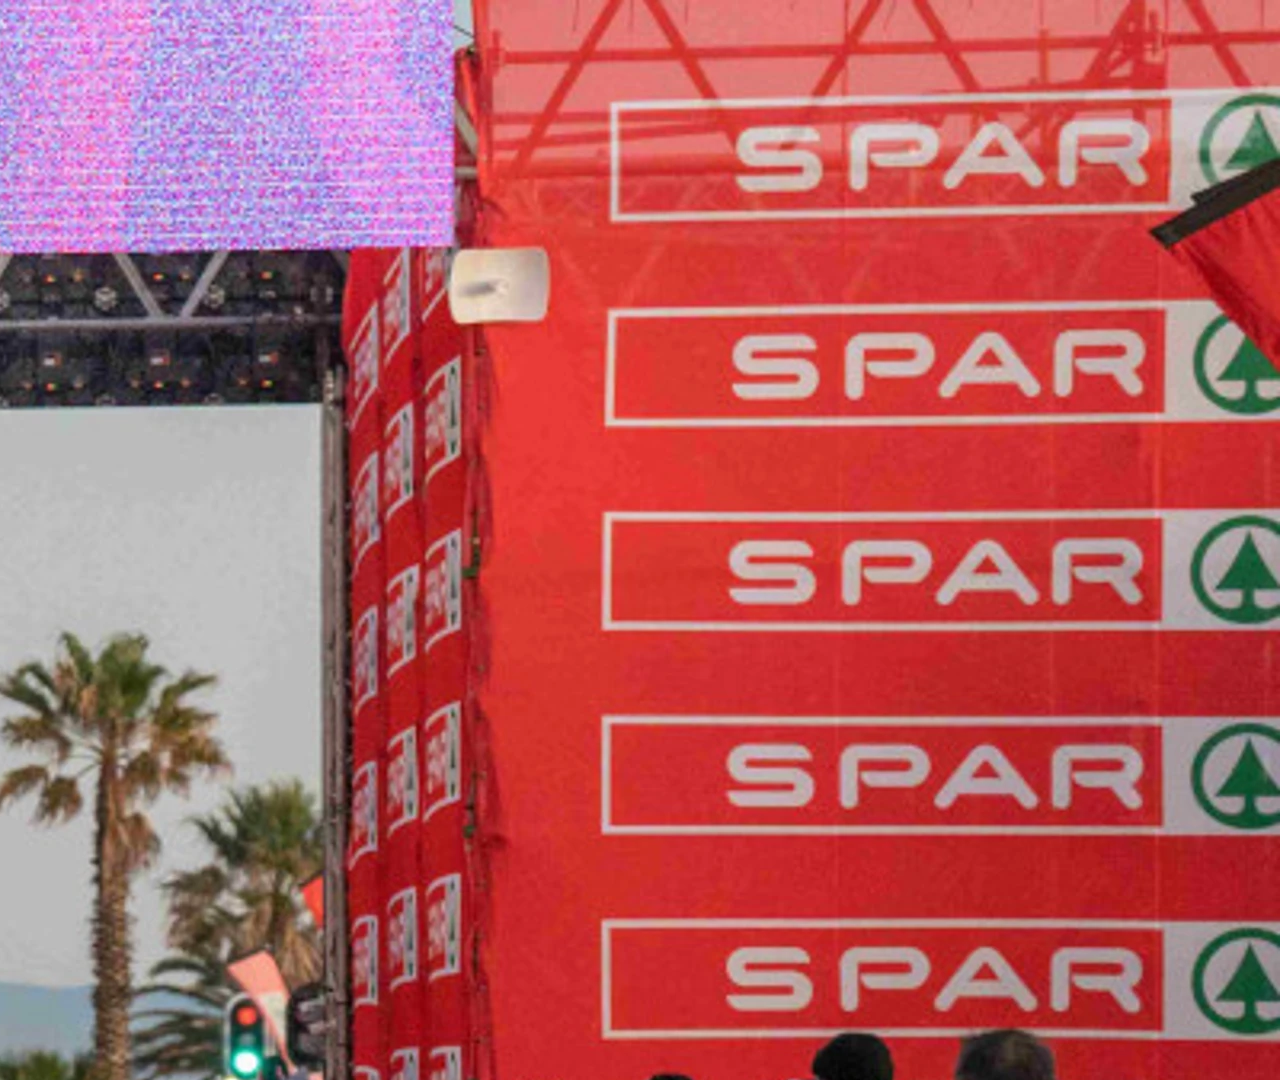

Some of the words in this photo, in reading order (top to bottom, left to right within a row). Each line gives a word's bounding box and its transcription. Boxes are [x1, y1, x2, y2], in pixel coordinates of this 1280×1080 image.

[736, 120, 1151, 192] SPAR
[732, 330, 1146, 400] SPAR
[728, 539, 1145, 605] SPAR
[726, 744, 1144, 810] SPAR
[726, 946, 1142, 1013] SPAR
